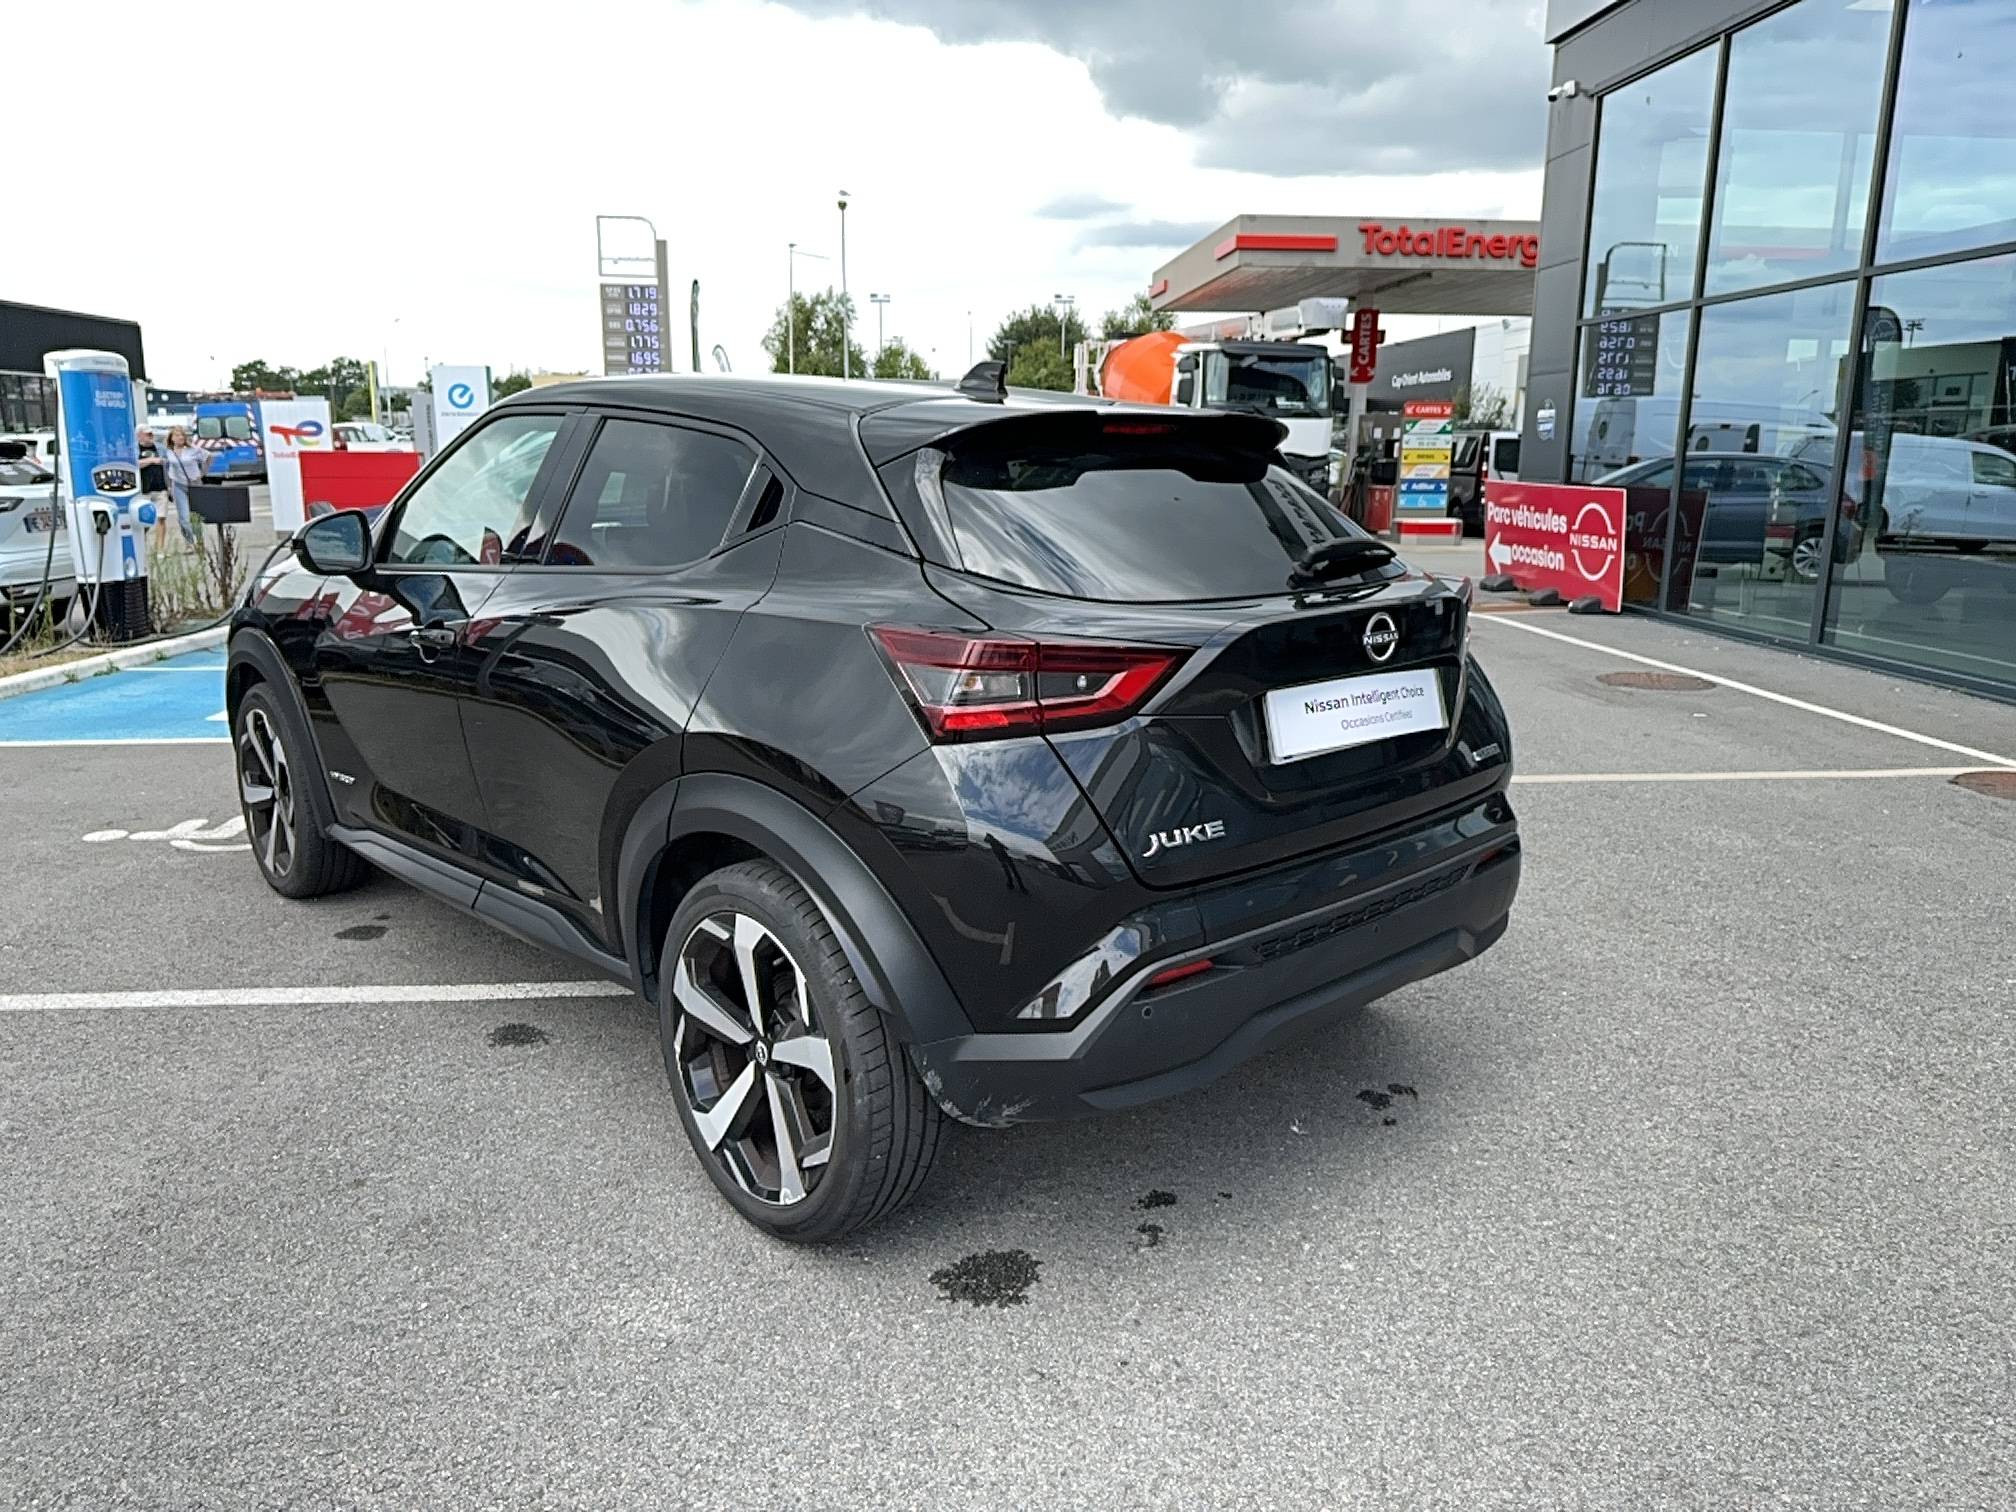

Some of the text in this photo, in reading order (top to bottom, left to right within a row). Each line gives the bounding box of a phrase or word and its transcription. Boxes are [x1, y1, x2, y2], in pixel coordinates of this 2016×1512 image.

[1358, 223, 1537, 267] TotalEnerg
[1357, 313, 1372, 365] CARTES
[1487, 502, 1568, 533] Parc véhicules
[1511, 543, 1565, 571] occasion
[1569, 533, 1618, 551] NISSAN
[1363, 632, 1399, 645] NISSAN
[1304, 685, 1424, 714] Nissan Intelligent Choice
[1142, 820, 1226, 857] JUKE
